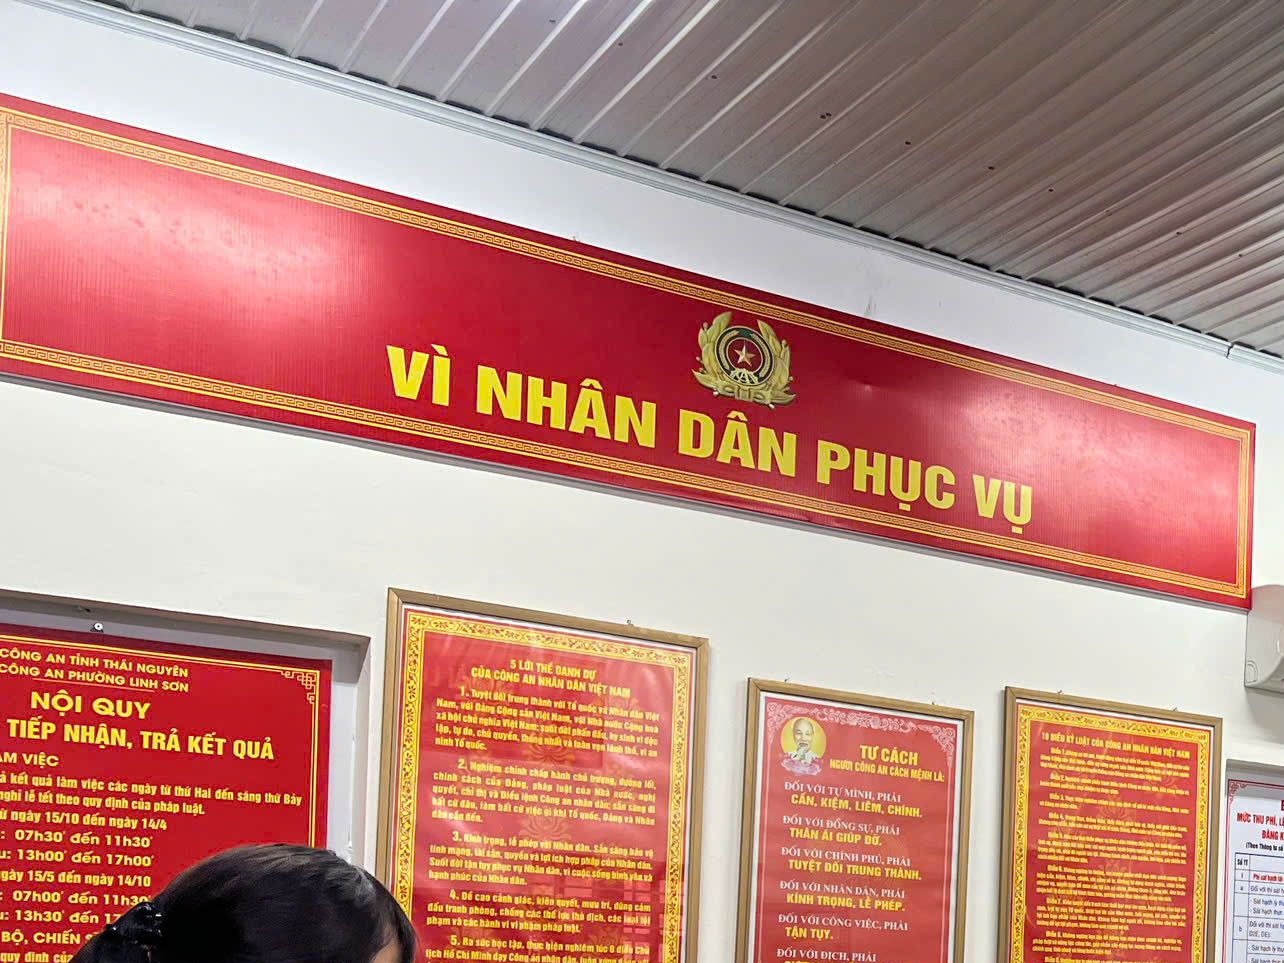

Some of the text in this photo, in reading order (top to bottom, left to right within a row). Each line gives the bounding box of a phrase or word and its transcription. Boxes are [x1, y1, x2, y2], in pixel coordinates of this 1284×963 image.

[386, 344, 1033, 534] VÌ NHÂN DÂN PHỤC VỤ
[0, 647, 188, 678] CÔNG AN TỈNH THÁI NGUYÊN
[44, 668, 64, 679] AN
[68, 671, 125, 685] PHƯỜNG
[129, 677, 158, 689] LINH
[162, 680, 189, 692] SƠN
[471, 667, 631, 698] CỦA CÔNG AN NHÂN DÂN VIỆT NAM
[31, 689, 151, 719] NỘI QUY
[7, 715, 274, 760] TIẾP NHẬN, TRẢ KẾT QUẢ
[22, 752, 59, 769] VIỆC
[860, 745, 918, 766] TƯ CÁCH
[10, 771, 28, 785] kết
[32, 774, 53, 787] quả
[56, 776, 78, 788] làm
[81, 778, 104, 792] việc
[108, 781, 128, 792] các
[131, 783, 157, 796] ngày
[160, 785, 172, 795] từ
[174, 786, 191, 797] thứ
[194, 787, 211, 799] Hai
[215, 787, 234, 800] đến
[237, 791, 261, 803] sáng
[265, 792, 281, 804] thứ
[283, 793, 302, 806] Bảy
[24, 791, 36, 802] lễ
[38, 792, 53, 804] tết
[55, 793, 80, 805] theo
[83, 797, 103, 808] quy
[105, 797, 129, 810] định
[131, 798, 151, 811] của
[153, 801, 180, 814] pháp
[182, 802, 205, 816] luật.
[791, 794, 922, 817] CẦN, KIỆM, LIÊM, CHÍNH.
[10, 810, 41, 823] ngày
[45, 811, 80, 824] 15/10
[83, 813, 106, 826] đến
[109, 816, 138, 830] ngày
[142, 818, 167, 830] 14/4
[70, 831, 100, 845] đến
[790, 827, 882, 846] THÂN ÁI GIÚP ĐỠ.
[71, 851, 101, 864] đến
[0, 869, 151, 887] gày 15/5 đến ngày 14/10
[789, 859, 922, 880] TUYỆT ĐỐI TRUNG THÀNH.
[787, 893, 905, 911] KÍNH TRỌNG, LỄ PHÉP.
[1, 929, 81, 946] BỘ, CHIẾN
[785, 926, 833, 941] TẬN TỤY.
